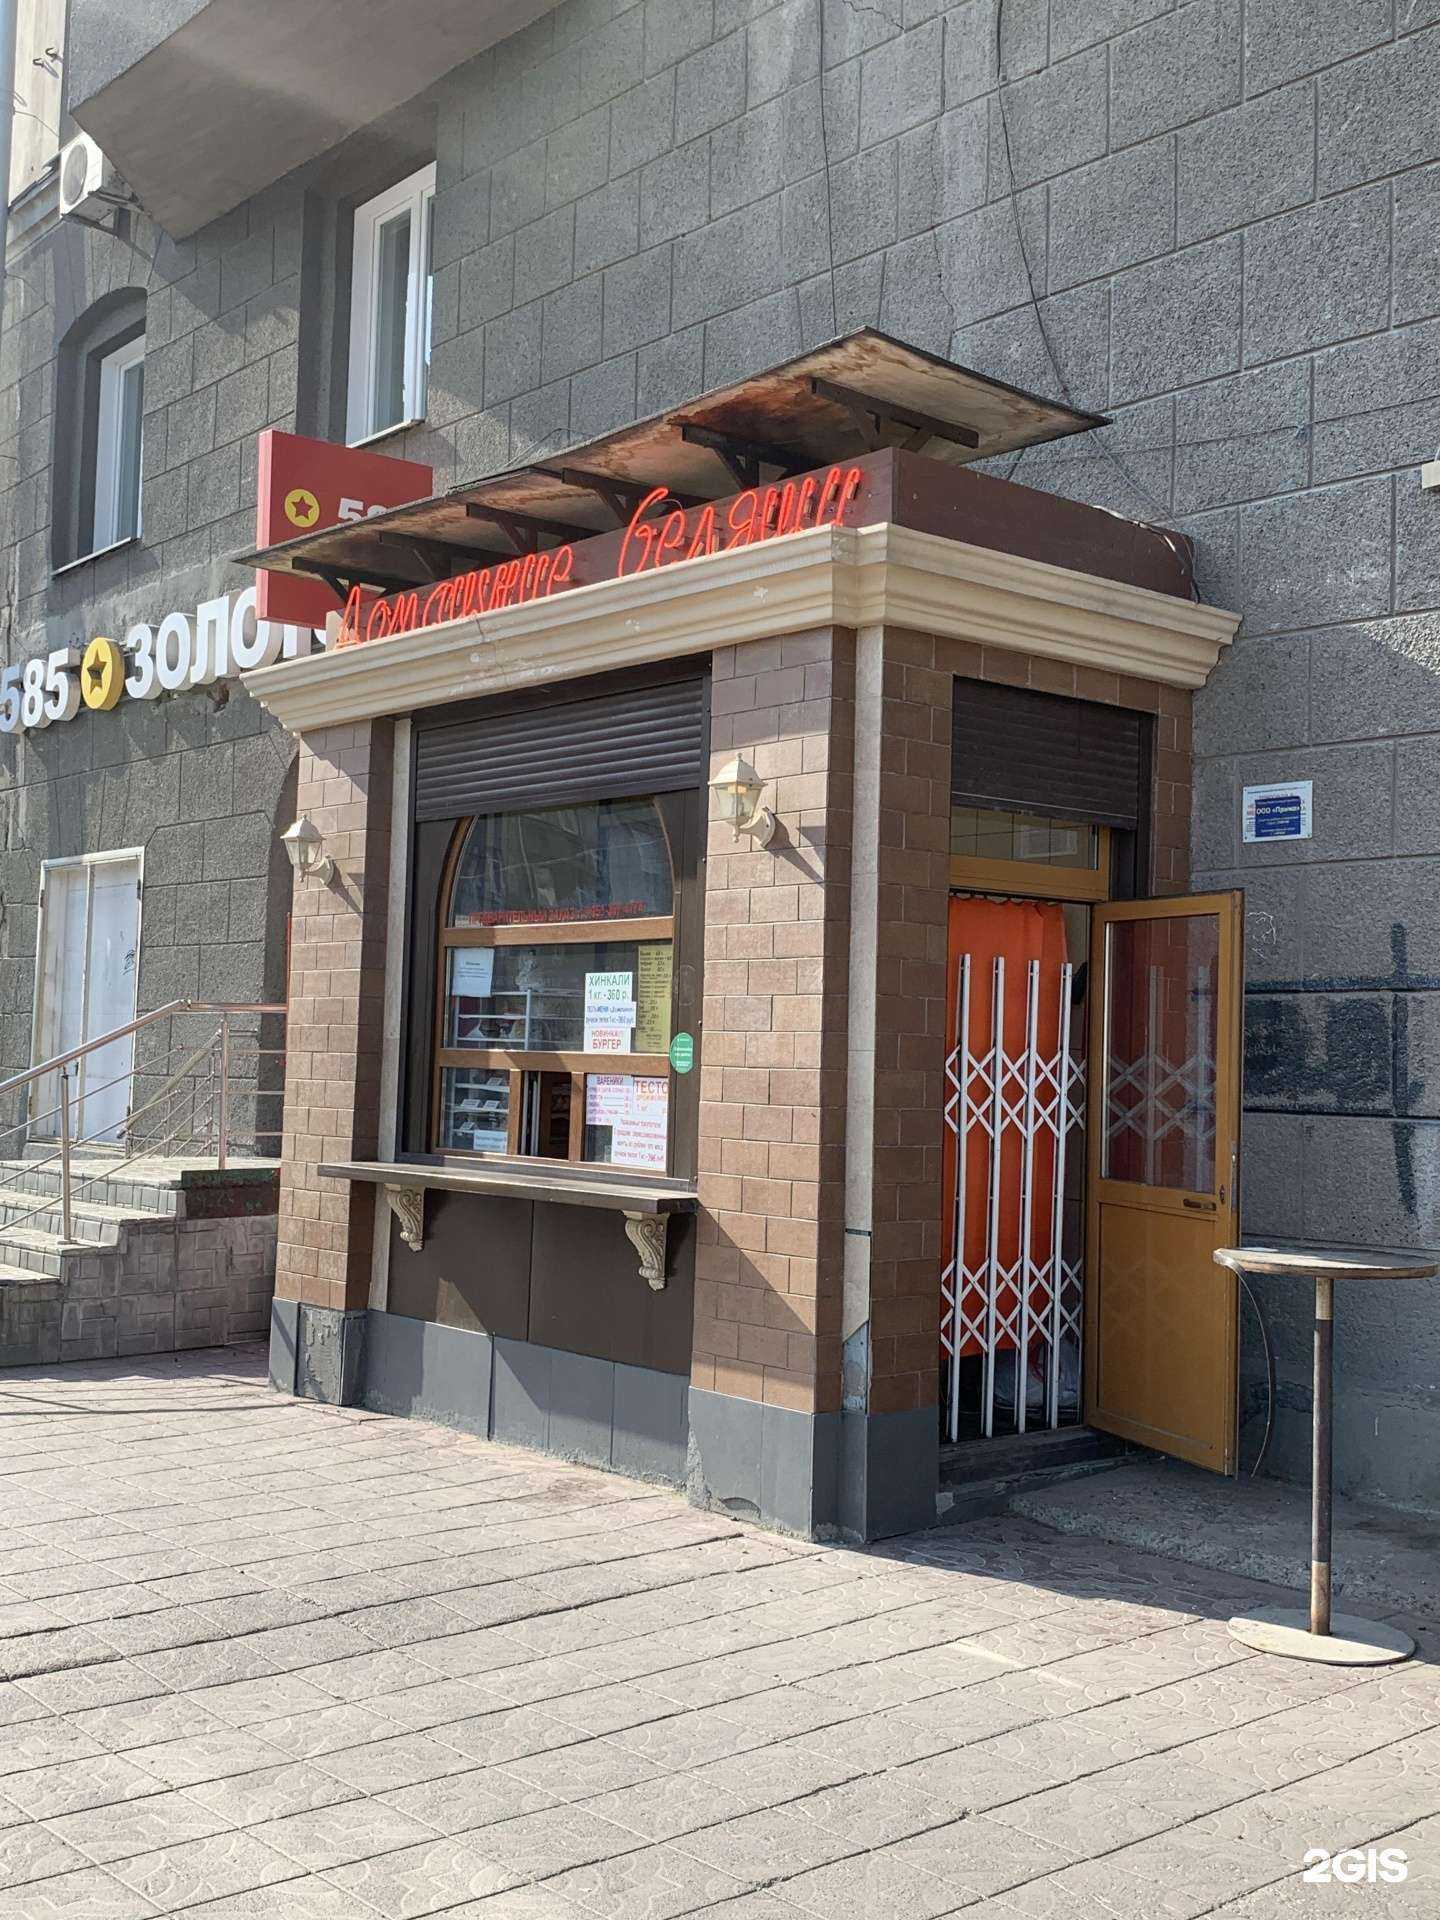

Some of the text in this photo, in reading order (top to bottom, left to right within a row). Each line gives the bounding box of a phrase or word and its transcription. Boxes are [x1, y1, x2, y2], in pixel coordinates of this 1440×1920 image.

[0, 586, 328, 734] 585 ЗОЛО
[589, 974, 630, 987] ХИНКАЛИ
[588, 989, 593, 1001] 1
[607, 988, 620, 1001] 360
[592, 1038, 622, 1050] БУРГЕР
